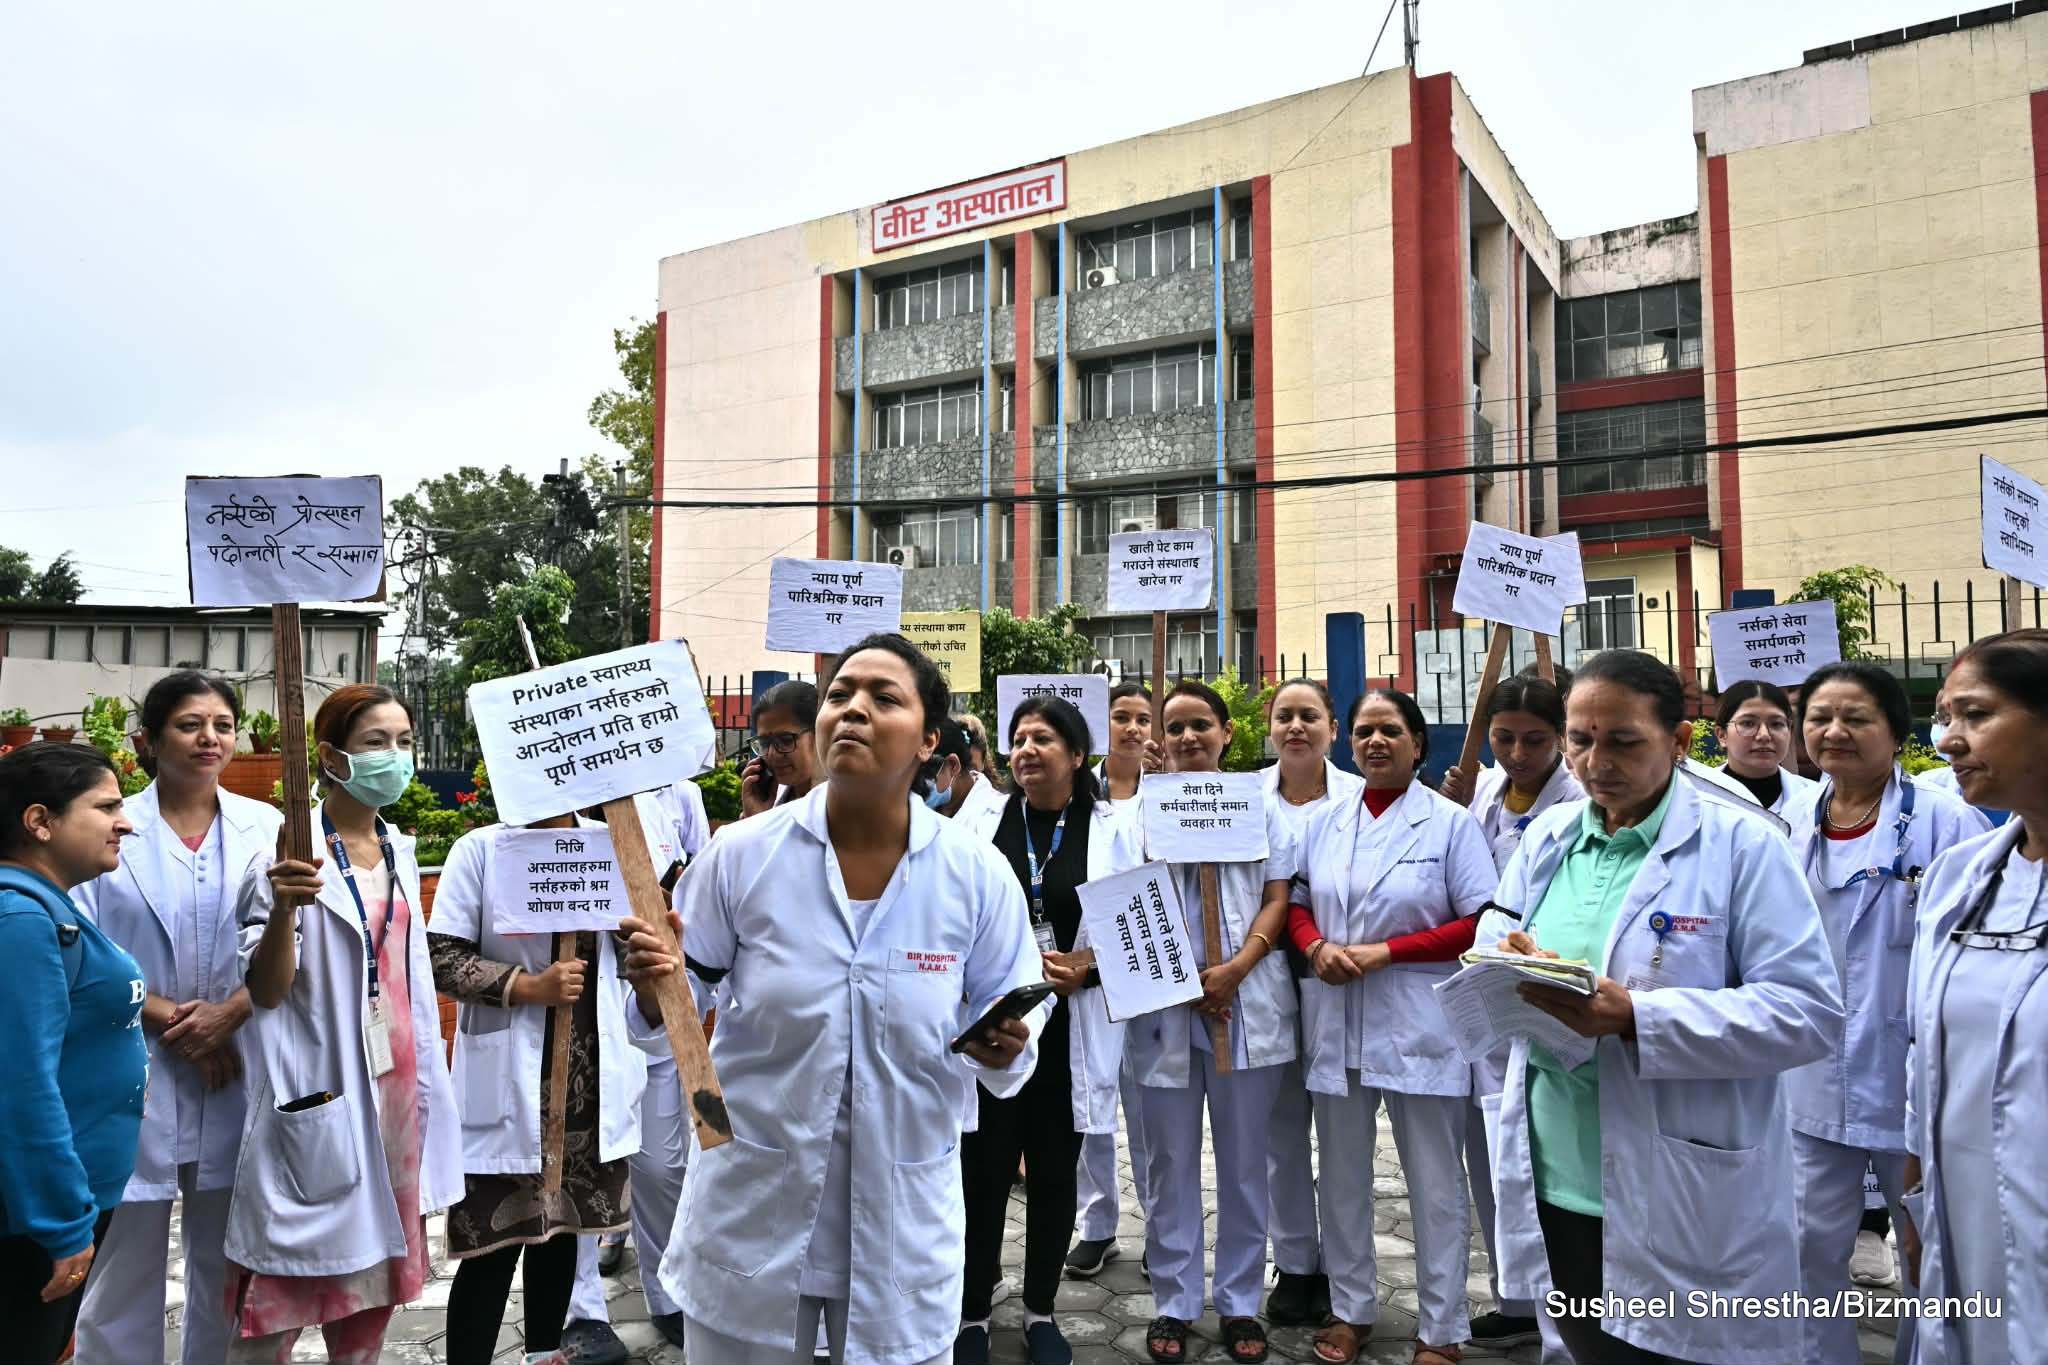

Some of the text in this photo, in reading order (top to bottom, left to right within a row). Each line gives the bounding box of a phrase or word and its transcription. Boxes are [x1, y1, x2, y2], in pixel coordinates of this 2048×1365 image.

[881, 174, 1055, 239] वीर अस्पताल
[1992, 476, 2039, 513] नर्सको सम्मान
[274, 496, 364, 536] प्रोत्साहन
[1129, 540, 1194, 555] खाली पेट काम
[1999, 530, 2034, 559] स्वाभिमान
[292, 545, 326, 573] र
[318, 545, 383, 576] सम्मान
[1499, 542, 1543, 566] न्याय पूर्ण
[1122, 557, 1154, 570] गराउने
[1477, 557, 1557, 587] पारिश्रमिक प्रदान
[811, 571, 863, 589] न्याय पूर्ण
[1138, 573, 1183, 586] खारेज गर
[788, 587, 884, 608] पारिश्रमिक प्रदान
[1505, 583, 1520, 598] गर
[825, 612, 844, 624] गर
[913, 622, 945, 632] संस्थामा
[947, 623, 966, 632] काम
[1738, 613, 1808, 633] नर्सको सेवा
[943, 640, 966, 651] उचित
[1744, 630, 1806, 651] समर्पणको
[1748, 655, 1780, 669] कदर
[512, 658, 651, 705] Private स्वास्थ्य
[1060, 683, 1083, 698] सेवा
[509, 678, 670, 735] संस्थाका नर्सहरुको
[516, 701, 679, 761] आन्दोलन प्रति हाम्रो
[544, 736, 664, 786] पूर्ण समर्थन छ
[1182, 782, 1224, 796] सेवा दिने
[1160, 798, 1248, 814] कर्मचारीलाई समान
[1179, 818, 1232, 830] व्यवहार गर
[555, 838, 584, 854] निजि
[527, 860, 612, 874] अस्पतालहरुमा
[529, 877, 609, 894] नर्सहरुको श्रम
[527, 898, 564, 912] शोषण
[594, 899, 611, 910] गर
[1128, 894, 1163, 980] न्युनतम ज्याला
[1147, 878, 1188, 984] सरकारले तोकेको
[1115, 912, 1141, 973] कायम गर
[924, 953, 957, 962] HOSPITAL
